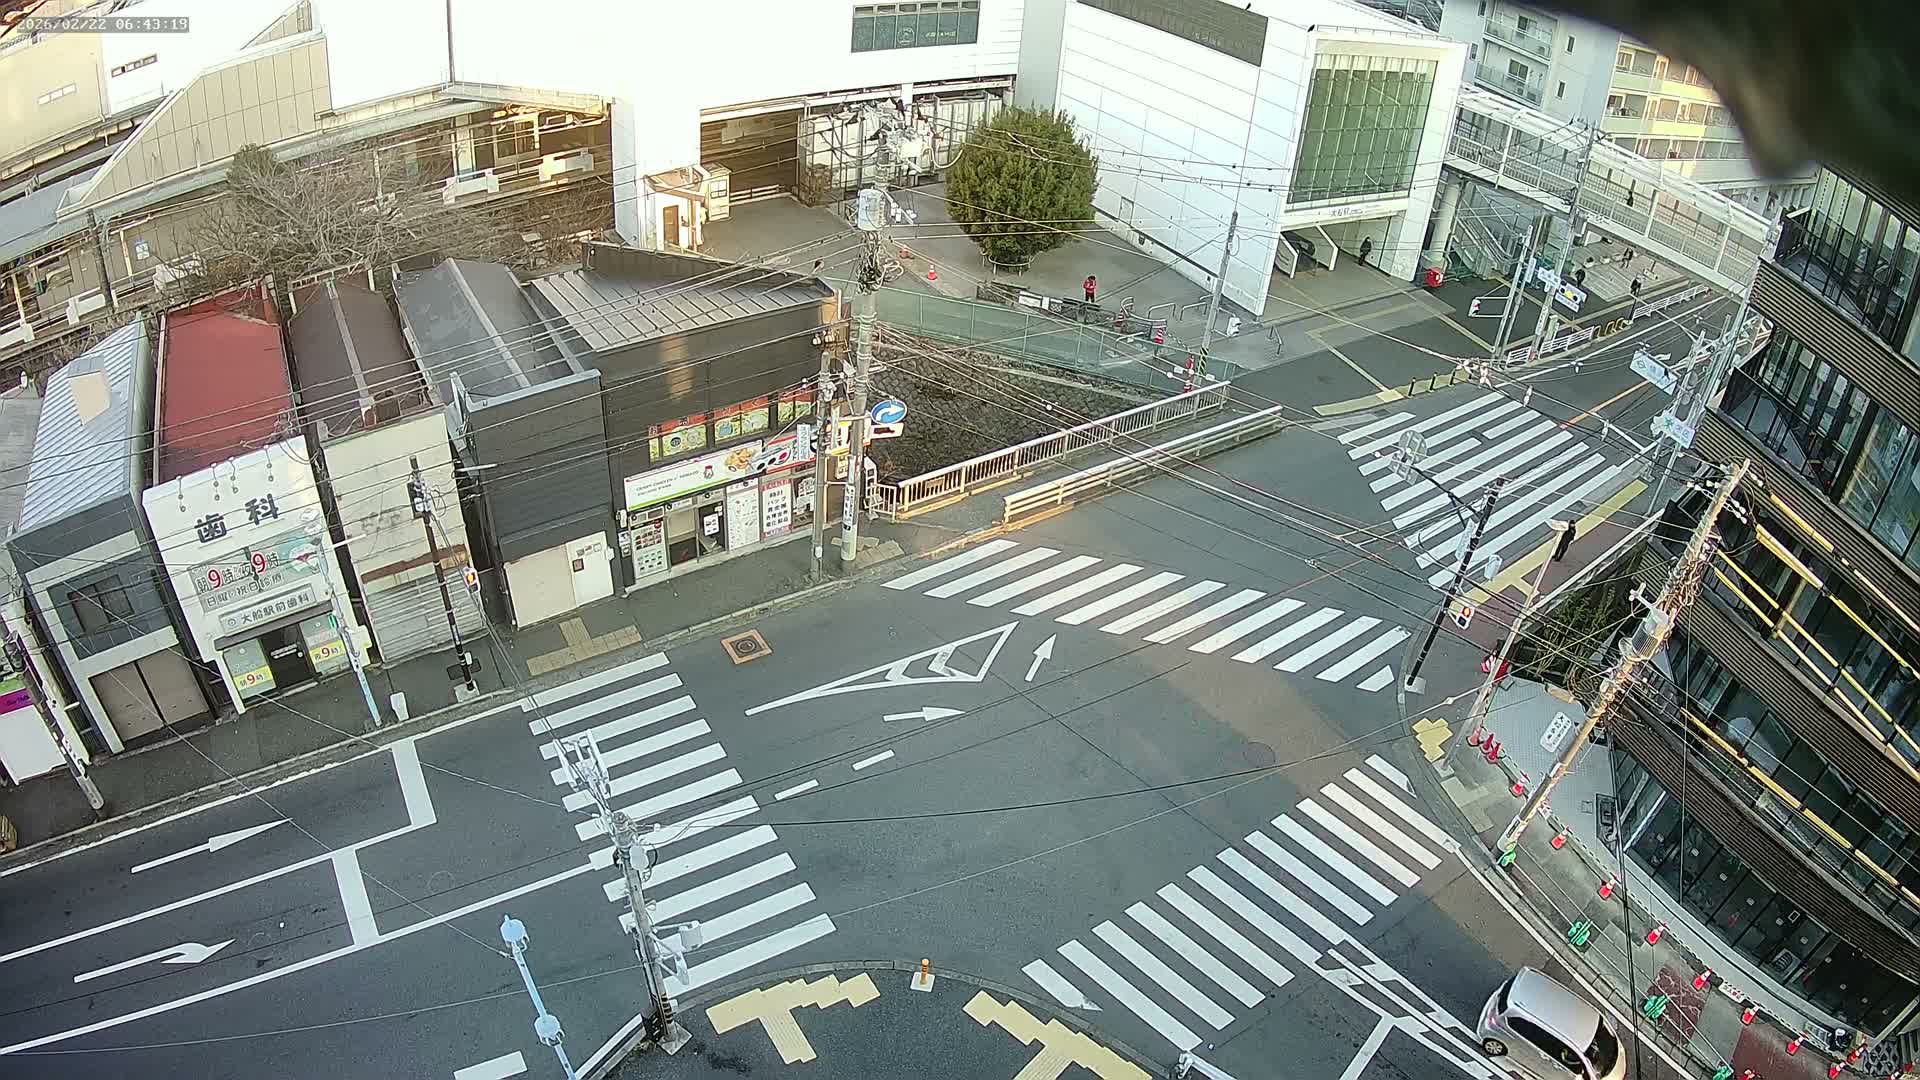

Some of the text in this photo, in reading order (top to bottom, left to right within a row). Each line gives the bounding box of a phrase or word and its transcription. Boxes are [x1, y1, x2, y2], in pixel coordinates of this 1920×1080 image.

[194, 493, 279, 543] 歯科
[241, 593, 310, 625] 大船駅前歯科
